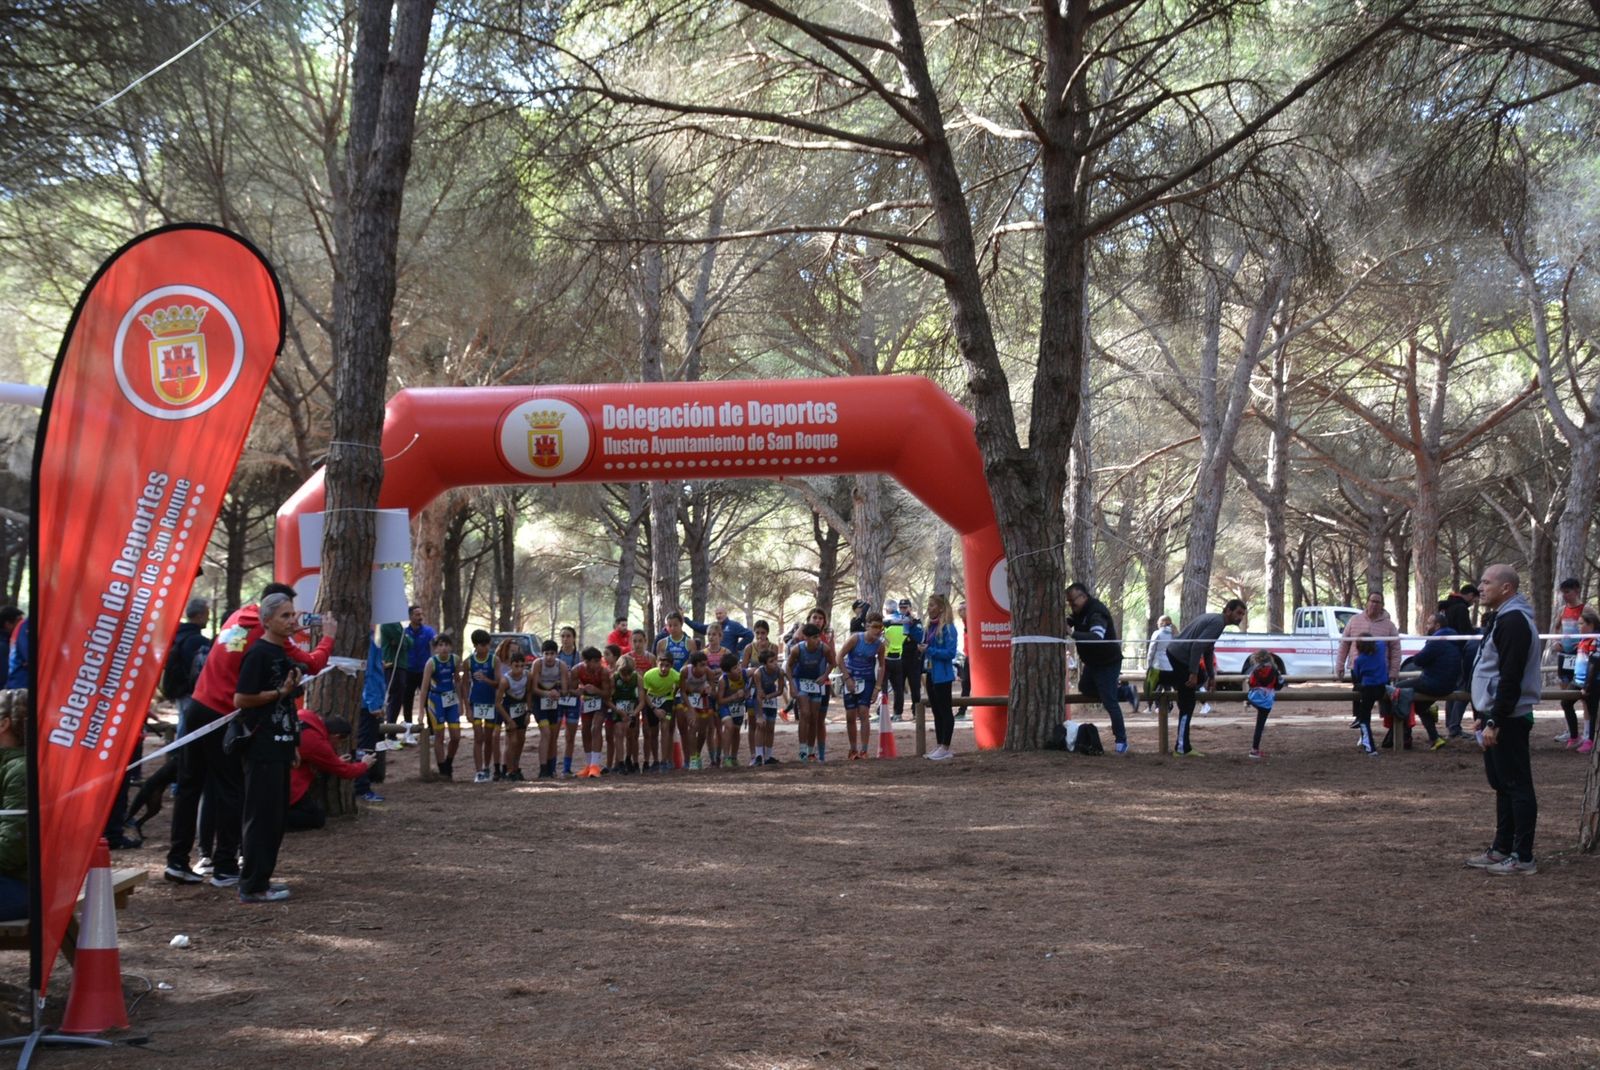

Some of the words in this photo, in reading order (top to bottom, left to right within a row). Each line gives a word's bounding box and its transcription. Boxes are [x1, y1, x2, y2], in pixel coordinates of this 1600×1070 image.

[602, 401, 715, 432] Delegación
[719, 402, 744, 427] de
[748, 400, 838, 428] Deportes
[603, 436, 649, 455] Ilustre
[651, 434, 745, 455] Ayuntamiento
[748, 433, 765, 451] de
[767, 432, 792, 450] San
[795, 432, 838, 450] Roque
[160, 478, 191, 530] Roque
[111, 471, 168, 578] Deportes
[148, 531, 172, 562] San
[140, 563, 161, 586] de
[102, 579, 130, 612] de
[99, 587, 152, 699] Ayuntamiento
[49, 614, 120, 748] Delegación
[804, 682, 816, 691] 35
[479, 707, 490, 716] 37
